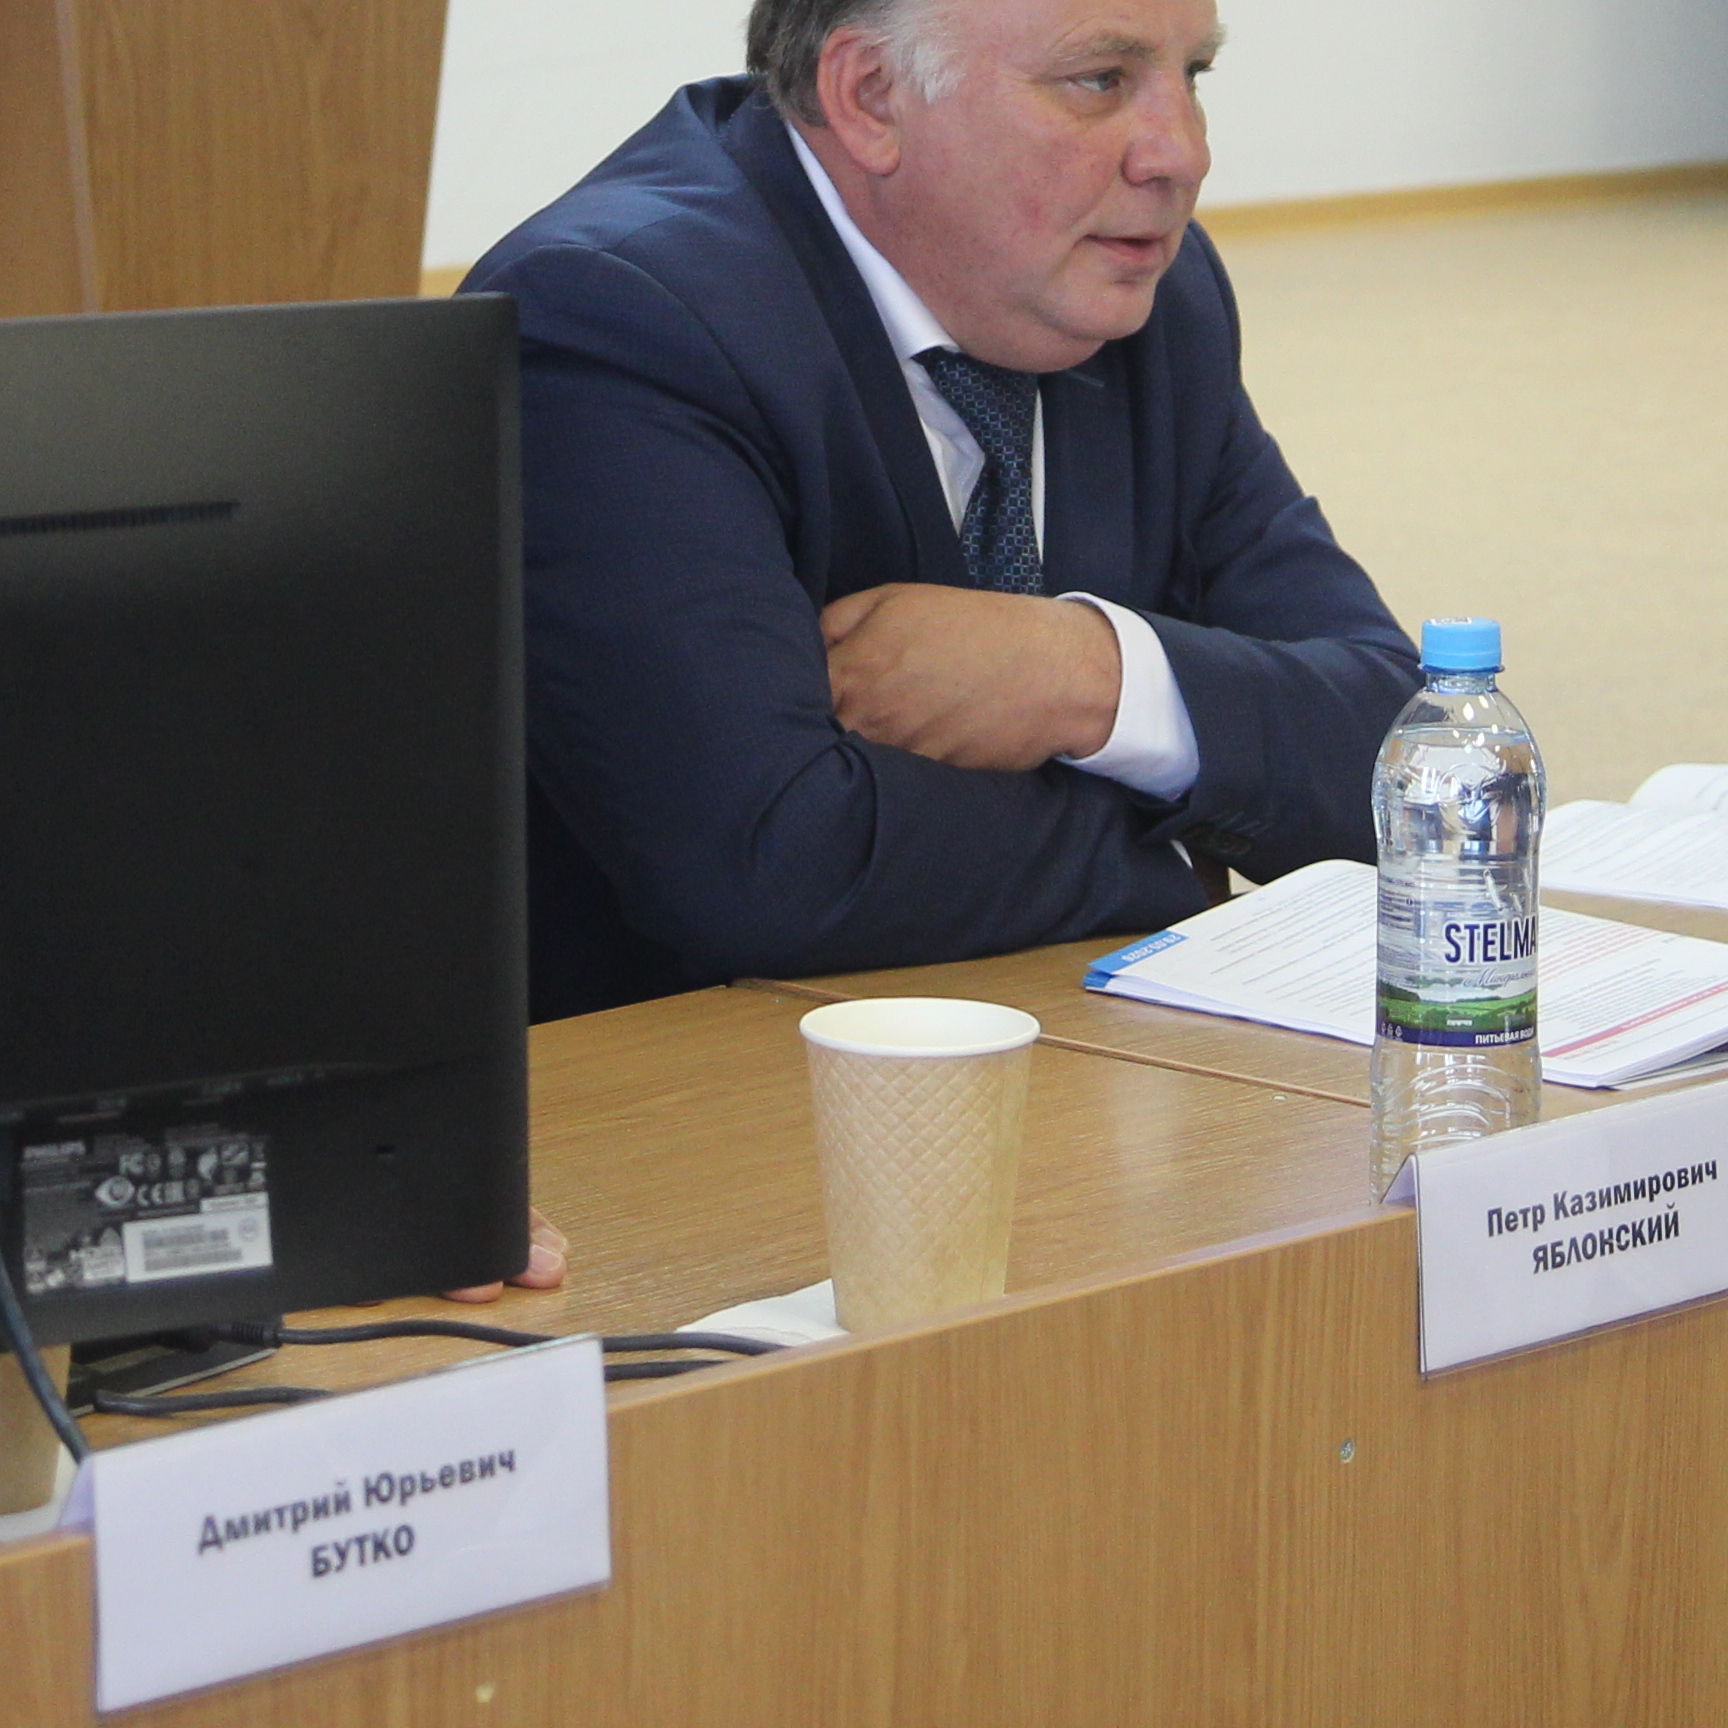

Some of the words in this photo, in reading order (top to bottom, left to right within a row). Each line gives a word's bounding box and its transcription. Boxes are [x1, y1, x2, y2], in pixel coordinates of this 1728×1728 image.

[1486, 1202, 1546, 1238] Петр
[1552, 1159, 1719, 1221] Казимирович
[1532, 1201, 1681, 1275] ЯБЛОНСКИЙ
[197, 1479, 352, 1557] Дмитрий
[363, 1448, 516, 1508] Юрьевич
[309, 1523, 415, 1578] БУТКО
